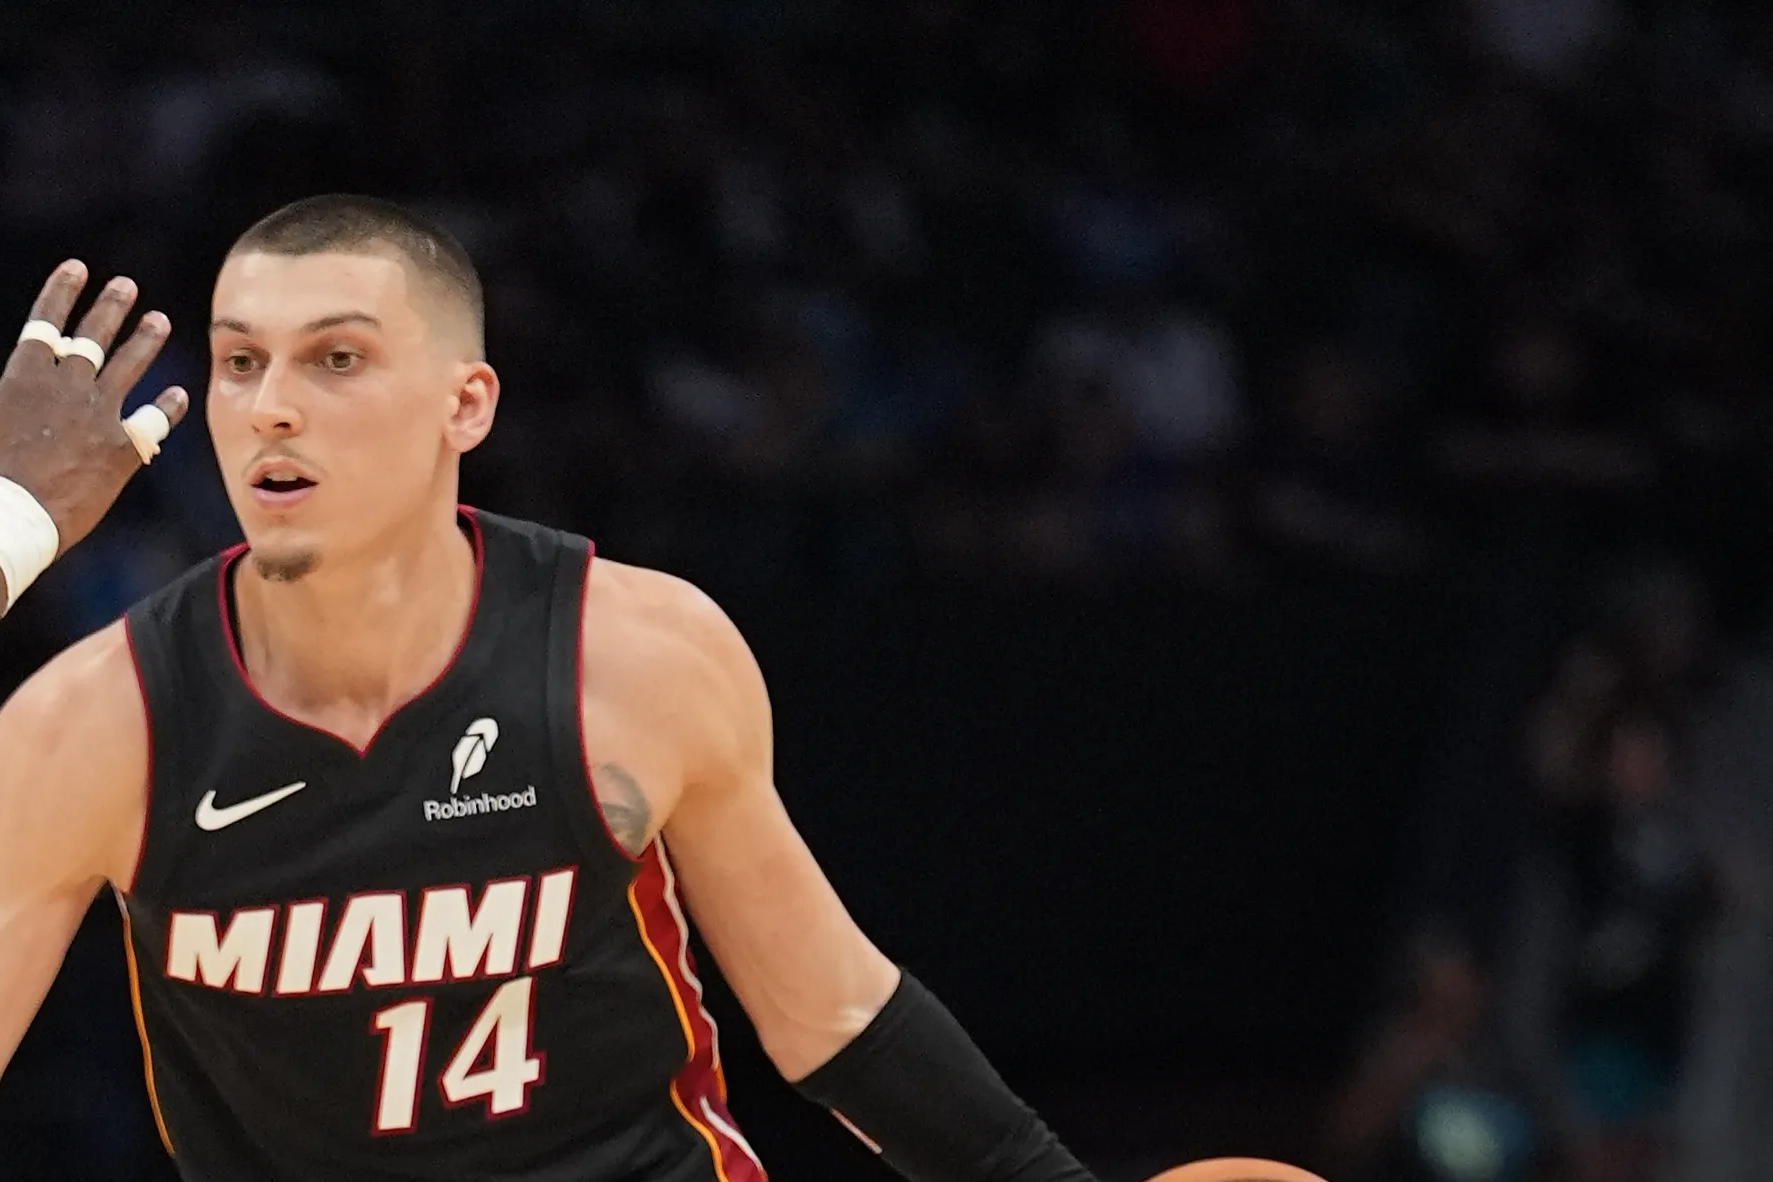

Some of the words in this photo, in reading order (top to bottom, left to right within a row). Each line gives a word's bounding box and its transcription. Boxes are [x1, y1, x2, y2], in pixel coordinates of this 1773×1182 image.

[423, 785, 538, 822] Robinhood
[164, 864, 578, 998] MIAMI
[370, 974, 547, 1138] 14
